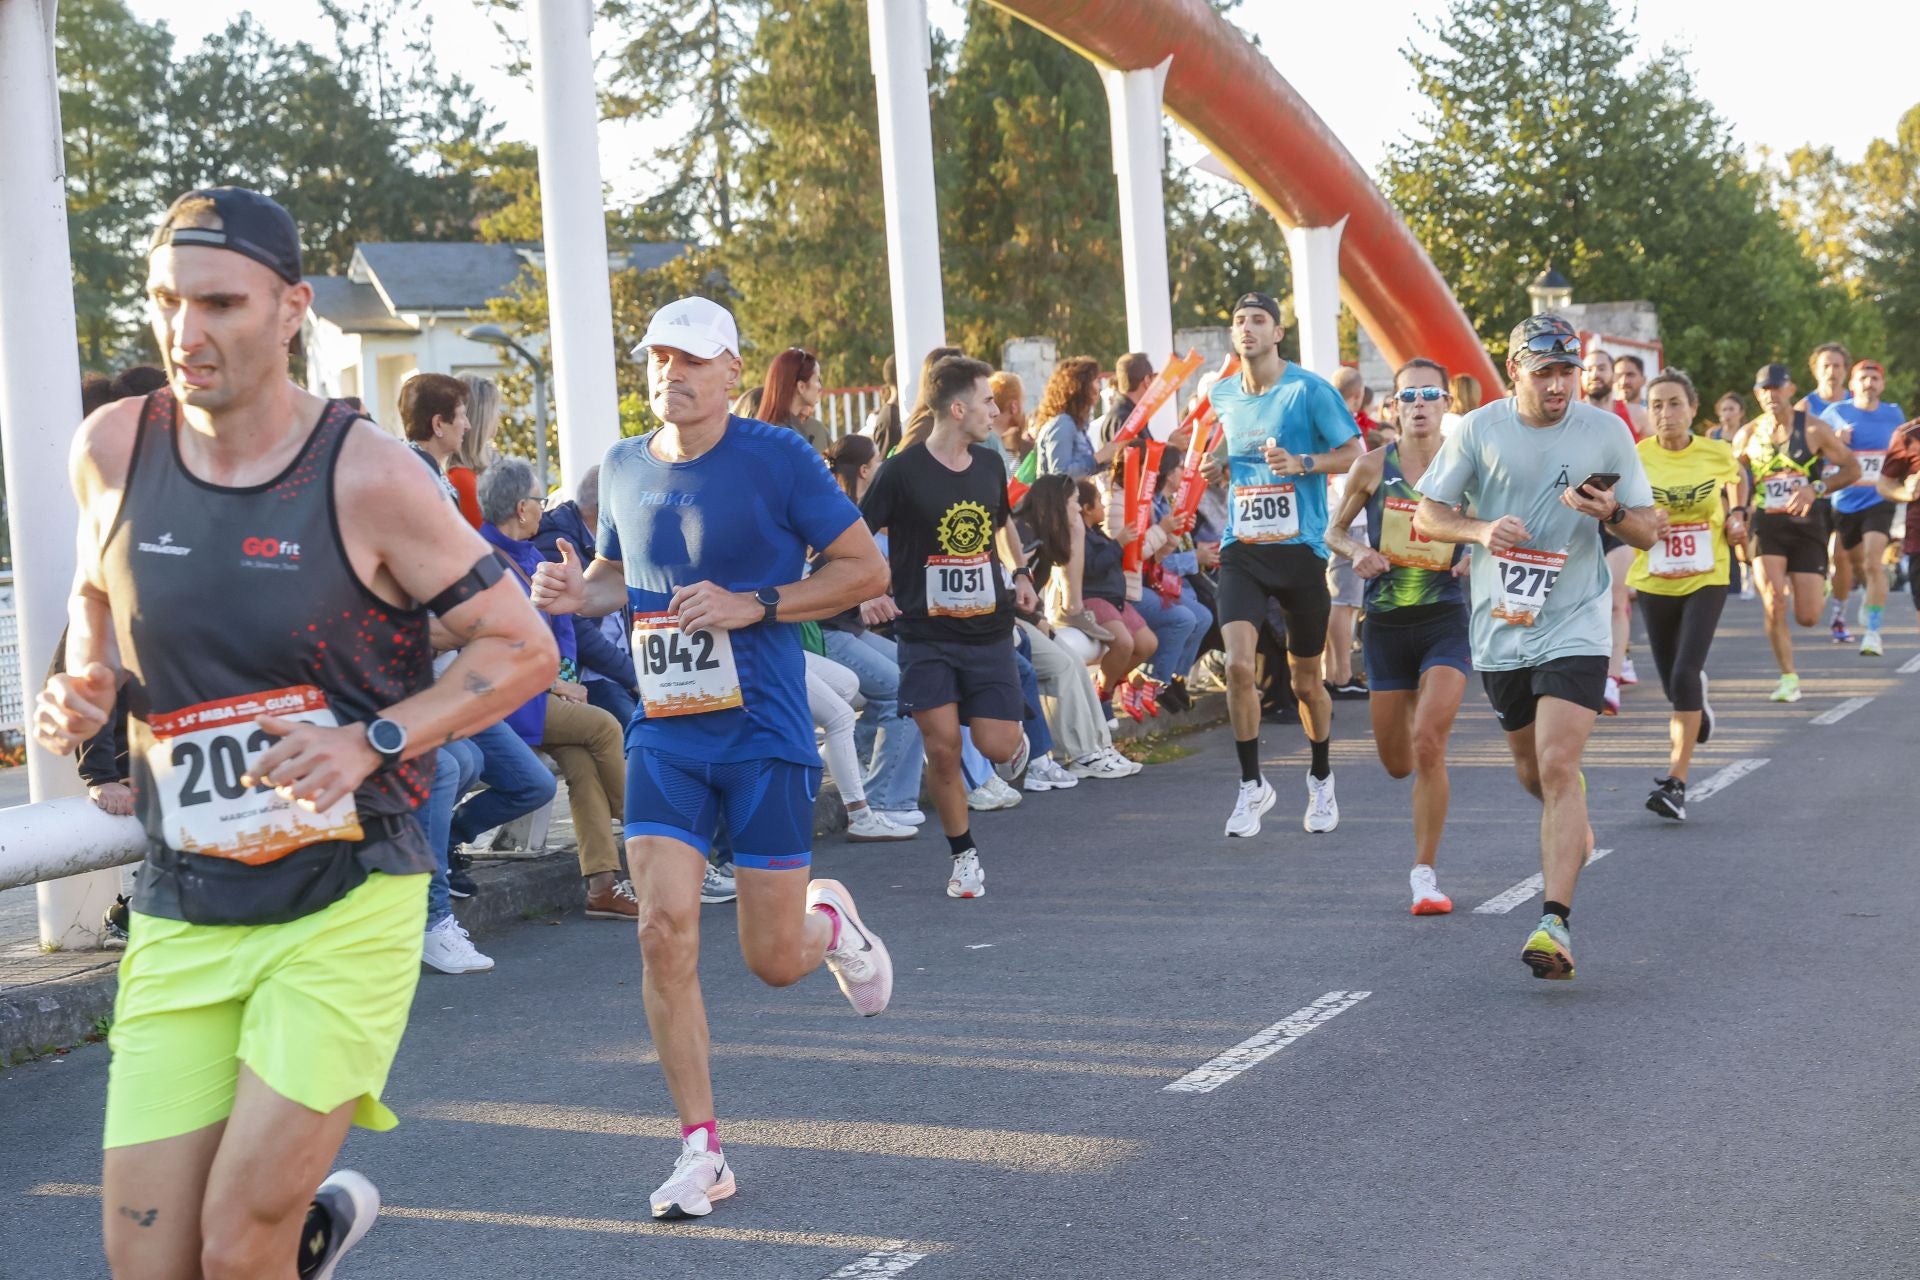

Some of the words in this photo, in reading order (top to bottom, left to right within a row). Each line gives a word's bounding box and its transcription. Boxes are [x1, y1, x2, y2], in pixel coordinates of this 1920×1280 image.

[1554, 464, 1569, 488] Ä
[640, 491, 696, 507] HOKO
[1240, 496, 1290, 522] 2508
[1664, 534, 1696, 558] 189
[939, 568, 985, 593] 1031
[639, 630, 720, 675] 1942
[198, 706, 236, 722] MBA
